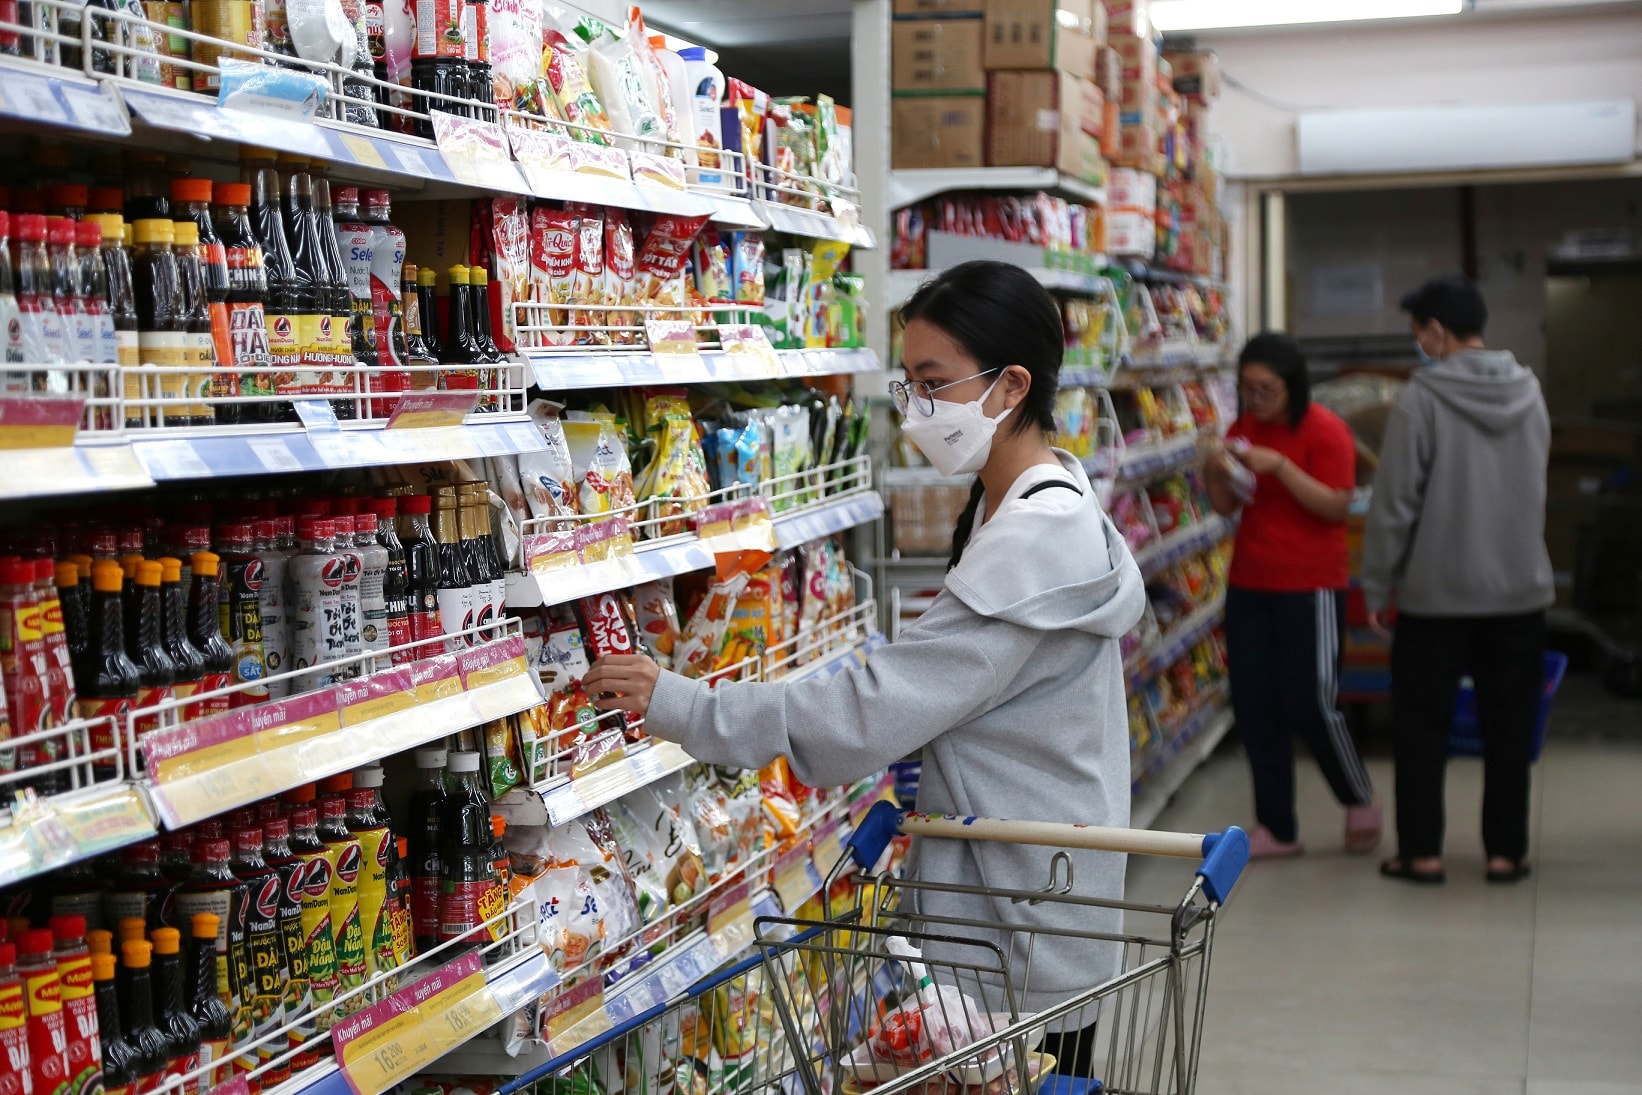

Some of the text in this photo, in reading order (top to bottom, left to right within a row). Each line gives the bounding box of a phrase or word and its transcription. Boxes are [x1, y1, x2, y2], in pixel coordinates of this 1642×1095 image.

[431, 977, 442, 994] mãi
[337, 1020, 361, 1043] Khuyến
[360, 1013, 373, 1031] mãi
